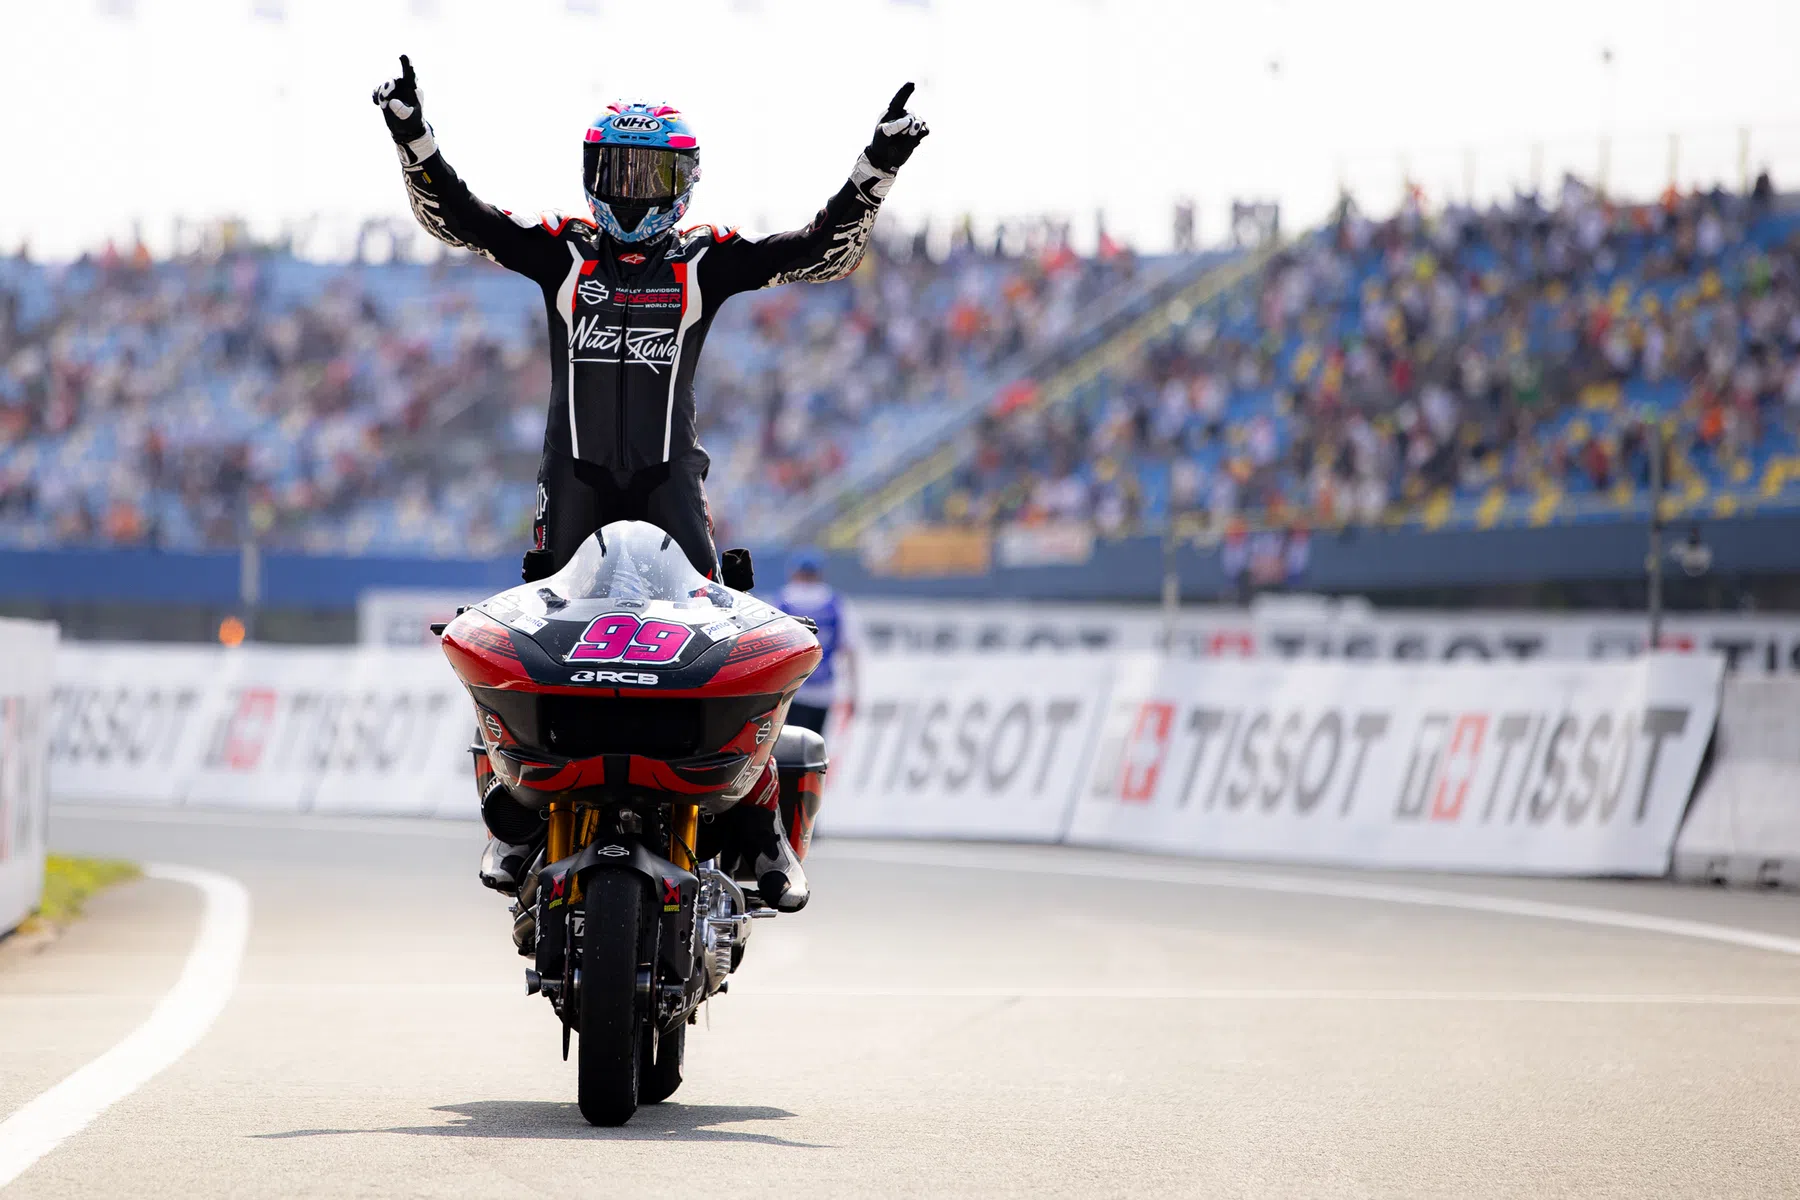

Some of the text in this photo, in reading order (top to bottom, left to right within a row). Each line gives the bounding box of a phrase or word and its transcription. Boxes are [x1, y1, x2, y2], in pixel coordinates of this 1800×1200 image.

[616, 117, 655, 129] NHK
[613, 292, 680, 303] BAGGER
[564, 612, 696, 664] 99
[855, 699, 1081, 794] TISSOT
[1179, 705, 1392, 819] TISSOT
[1481, 707, 1690, 824] TISSOT
